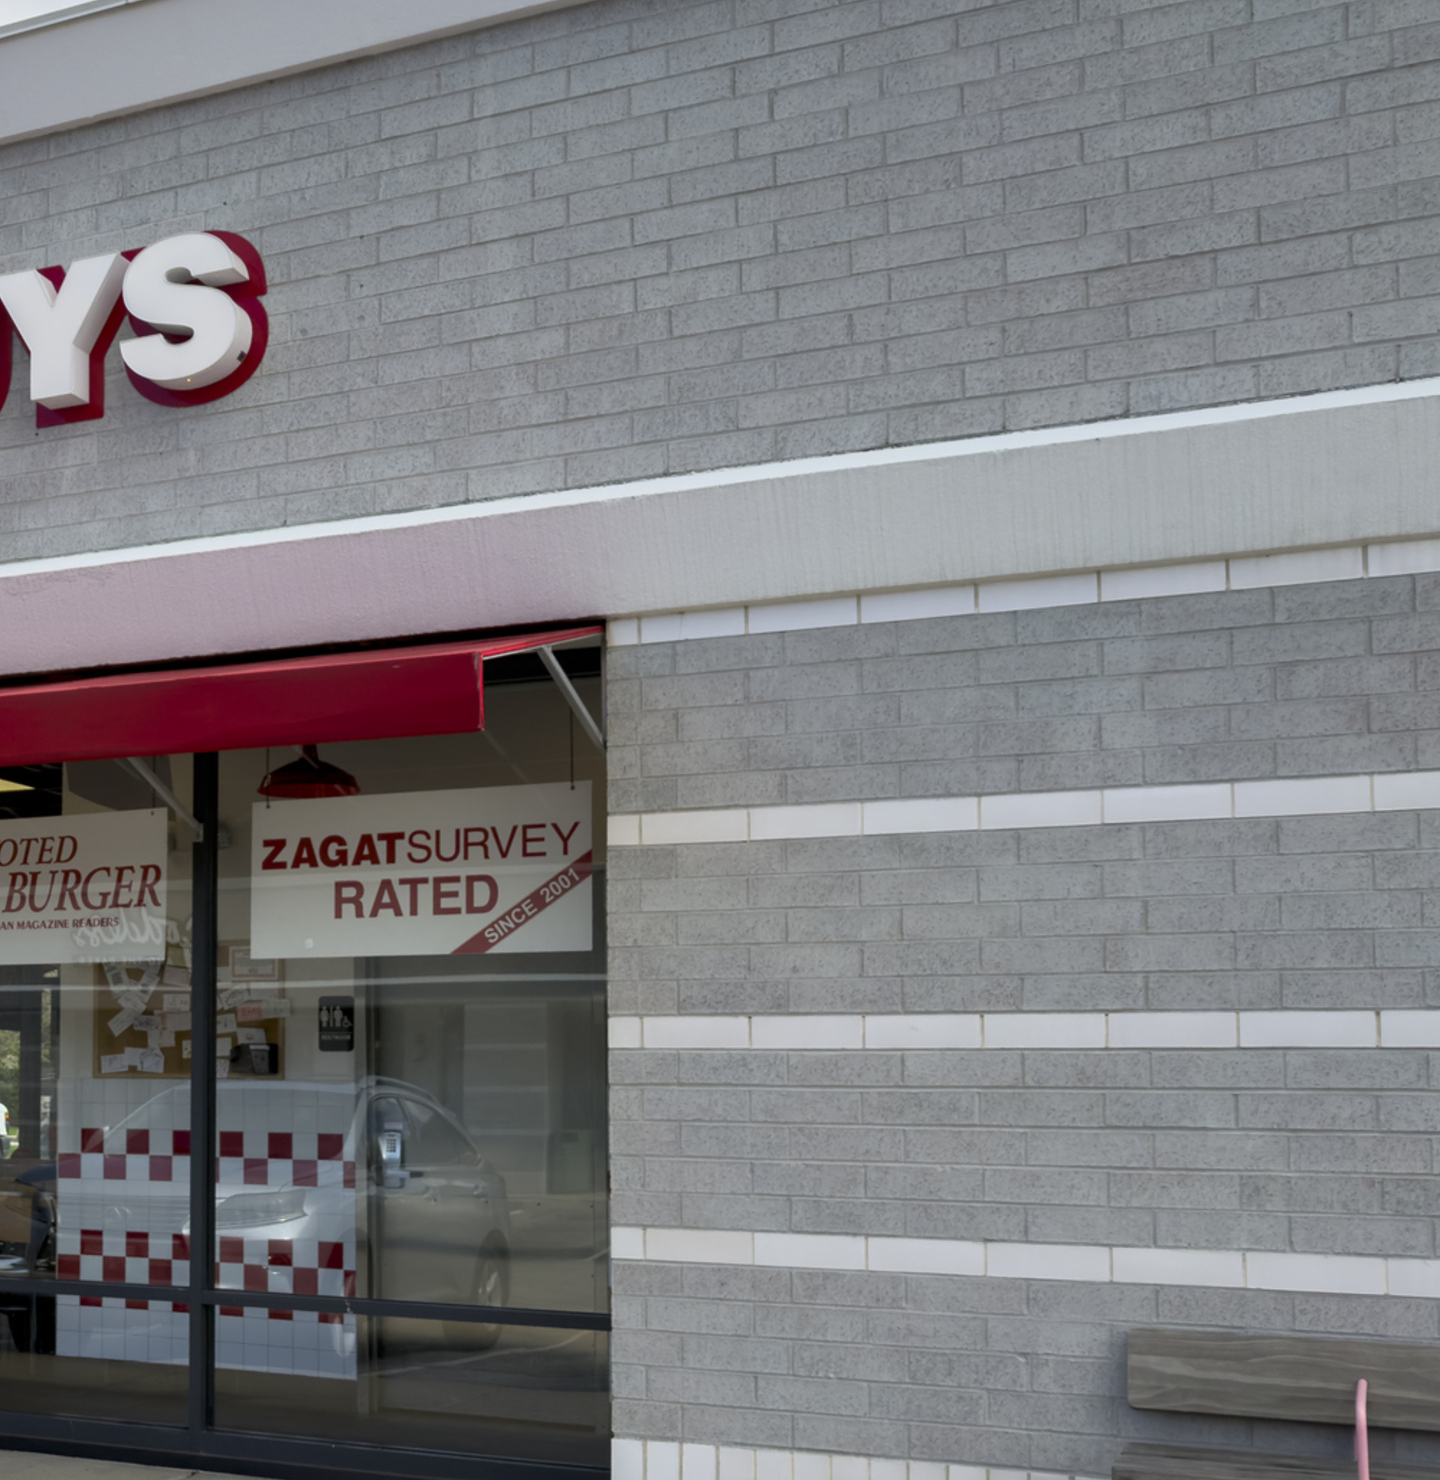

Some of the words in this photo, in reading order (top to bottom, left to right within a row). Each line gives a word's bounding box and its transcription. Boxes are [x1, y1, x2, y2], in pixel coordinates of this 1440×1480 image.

[1, 864, 162, 913] BURGER
[334, 874, 498, 919] RATED
[484, 898, 538, 944] SINCE
[539, 867, 581, 903] 2001
[16, 918, 69, 931] MAGAZINE
[71, 916, 120, 928] READERS
